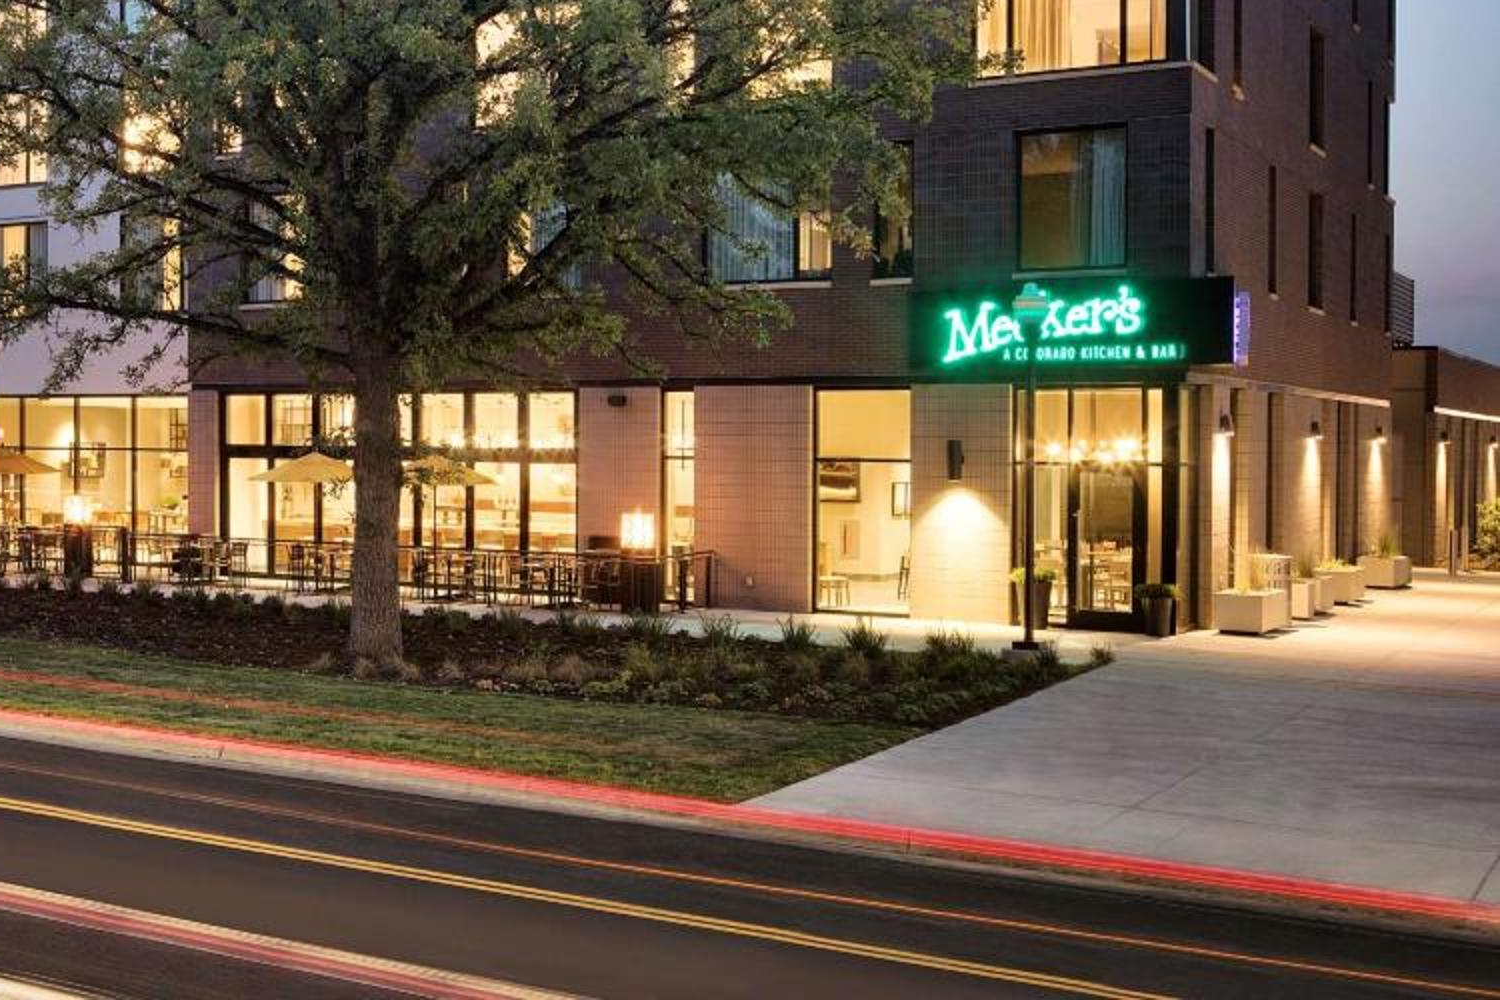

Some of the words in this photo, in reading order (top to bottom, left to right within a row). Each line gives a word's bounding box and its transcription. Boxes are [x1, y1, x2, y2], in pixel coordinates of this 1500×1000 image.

[1003, 347, 1011, 361] A
[1080, 345, 1131, 361] KITCHEN
[1135, 344, 1146, 360] &
[1151, 343, 1177, 360] BAR
